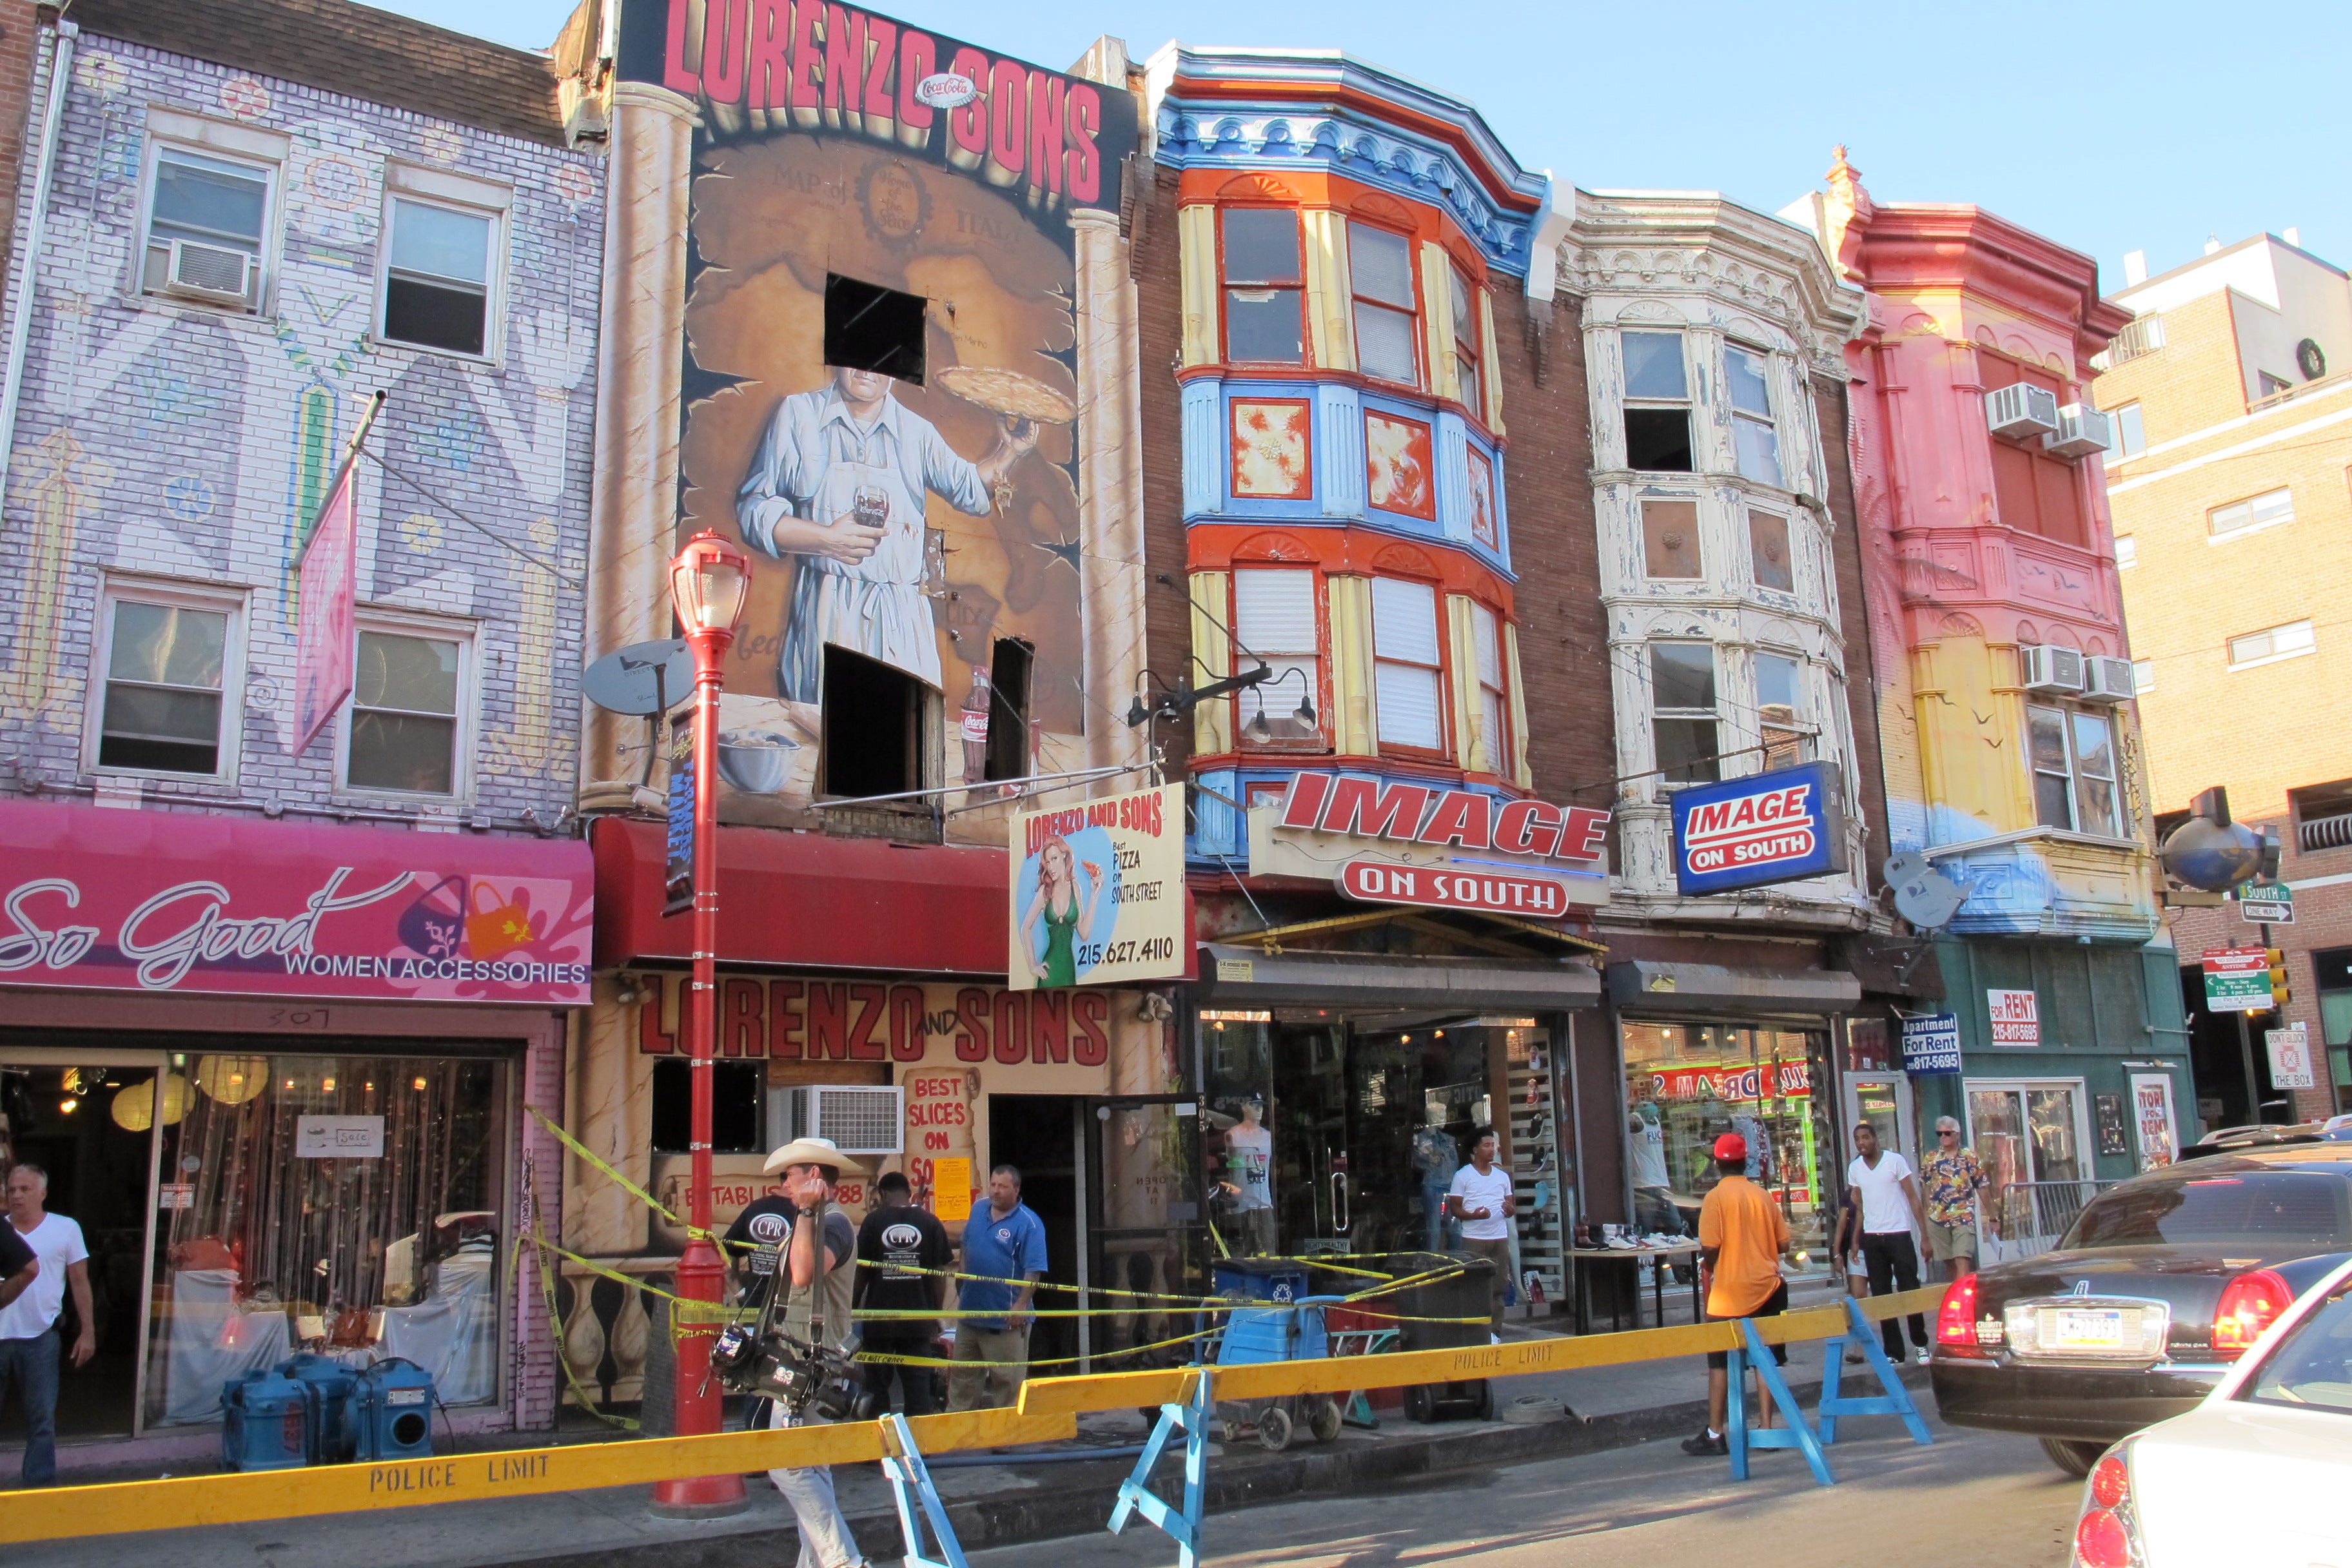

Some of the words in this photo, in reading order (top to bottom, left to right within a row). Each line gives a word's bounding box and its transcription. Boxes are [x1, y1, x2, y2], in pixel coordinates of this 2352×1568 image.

[922, 79, 969, 98] Coca-Cola
[663, 0, 936, 130] LORENZO
[951, 47, 1101, 203] SONS
[1280, 772, 1611, 861] IMAGE
[1687, 787, 1807, 836] IMAGE
[1026, 807, 1084, 859] LORENZO
[1088, 801, 1117, 828] AND
[1121, 791, 1162, 838] SONS
[1113, 850, 1141, 870] PIZZA
[1695, 849, 1725, 868] ON
[1734, 835, 1805, 861] SOUTH
[1111, 884, 1135, 904] SOUTH
[1135, 881, 1163, 901] STREET
[1359, 868, 1415, 897] ON
[1434, 876, 1555, 910] SOUTH
[2247, 885, 2279, 900] SOUTH
[2248, 906, 2262, 915] ONE
[0, 878, 101, 970] So
[119, 866, 416, 990] Good
[1077, 937, 1173, 966] 215.627.4110
[285, 953, 392, 977] WOMEN
[399, 957, 587, 984] ACCESSORIES
[267, 1008, 330, 1029] 307
[1991, 1006, 2003, 1017] FOR
[2003, 994, 2034, 1019] RENT
[919, 1012, 959, 1037] AND
[956, 988, 1108, 1066] SONS
[1903, 1017, 1955, 1035] Apartment
[2287, 1033, 2306, 1043] BLOCK
[1904, 1037, 1923, 1052] For
[1925, 1035, 1956, 1051] Rent
[914, 1078, 962, 1098] BEST
[2275, 1075, 2291, 1086] THE
[2294, 1074, 2311, 1086] BOX
[908, 1102, 966, 1127] SLICES
[340, 1133, 367, 1142] Sale
[924, 1132, 950, 1150] ON
[758, 1219, 782, 1237] CPR
[1454, 1350, 1502, 1370] POLICE
[1518, 1345, 1553, 1364] LIMIT
[370, 1463, 456, 1493] POLICE
[488, 1455, 549, 1482] LIMIT
